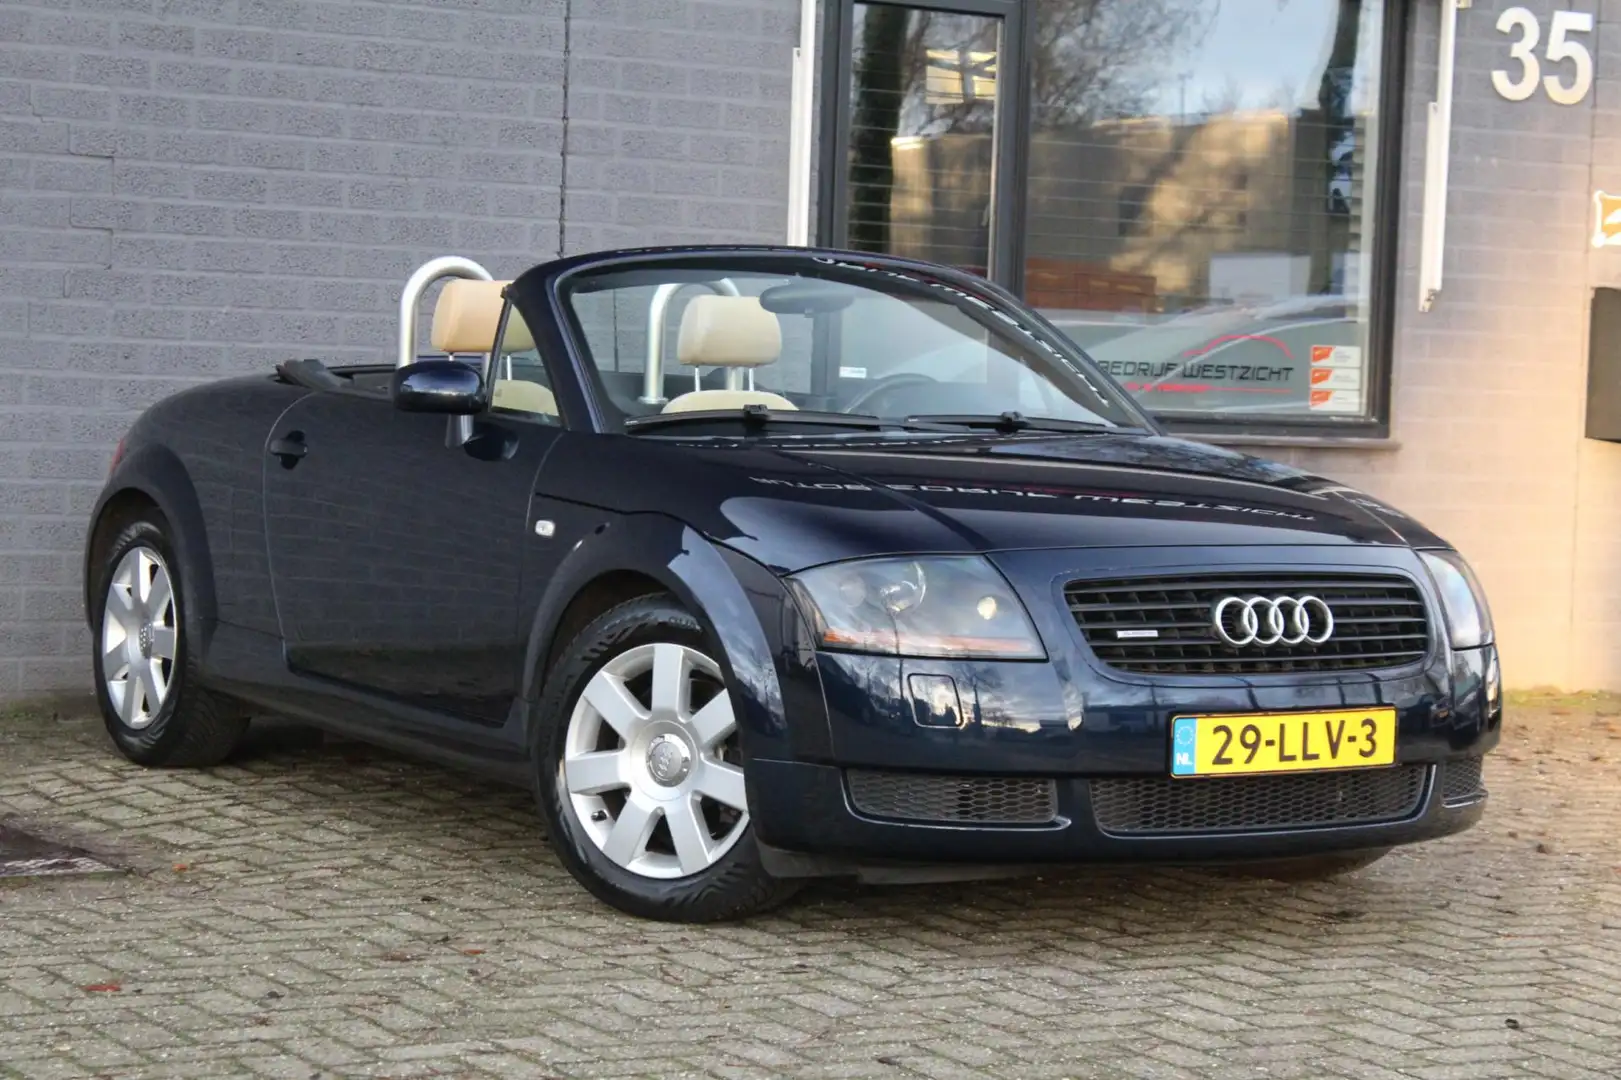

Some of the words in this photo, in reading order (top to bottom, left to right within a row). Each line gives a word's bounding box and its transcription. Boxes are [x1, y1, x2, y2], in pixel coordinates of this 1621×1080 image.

[1492, 8, 1593, 105] 35
[1183, 363, 1294, 380] WESTZICHT
[1211, 717, 1378, 766] 29-LLV-3
[1175, 752, 1193, 766] NL
